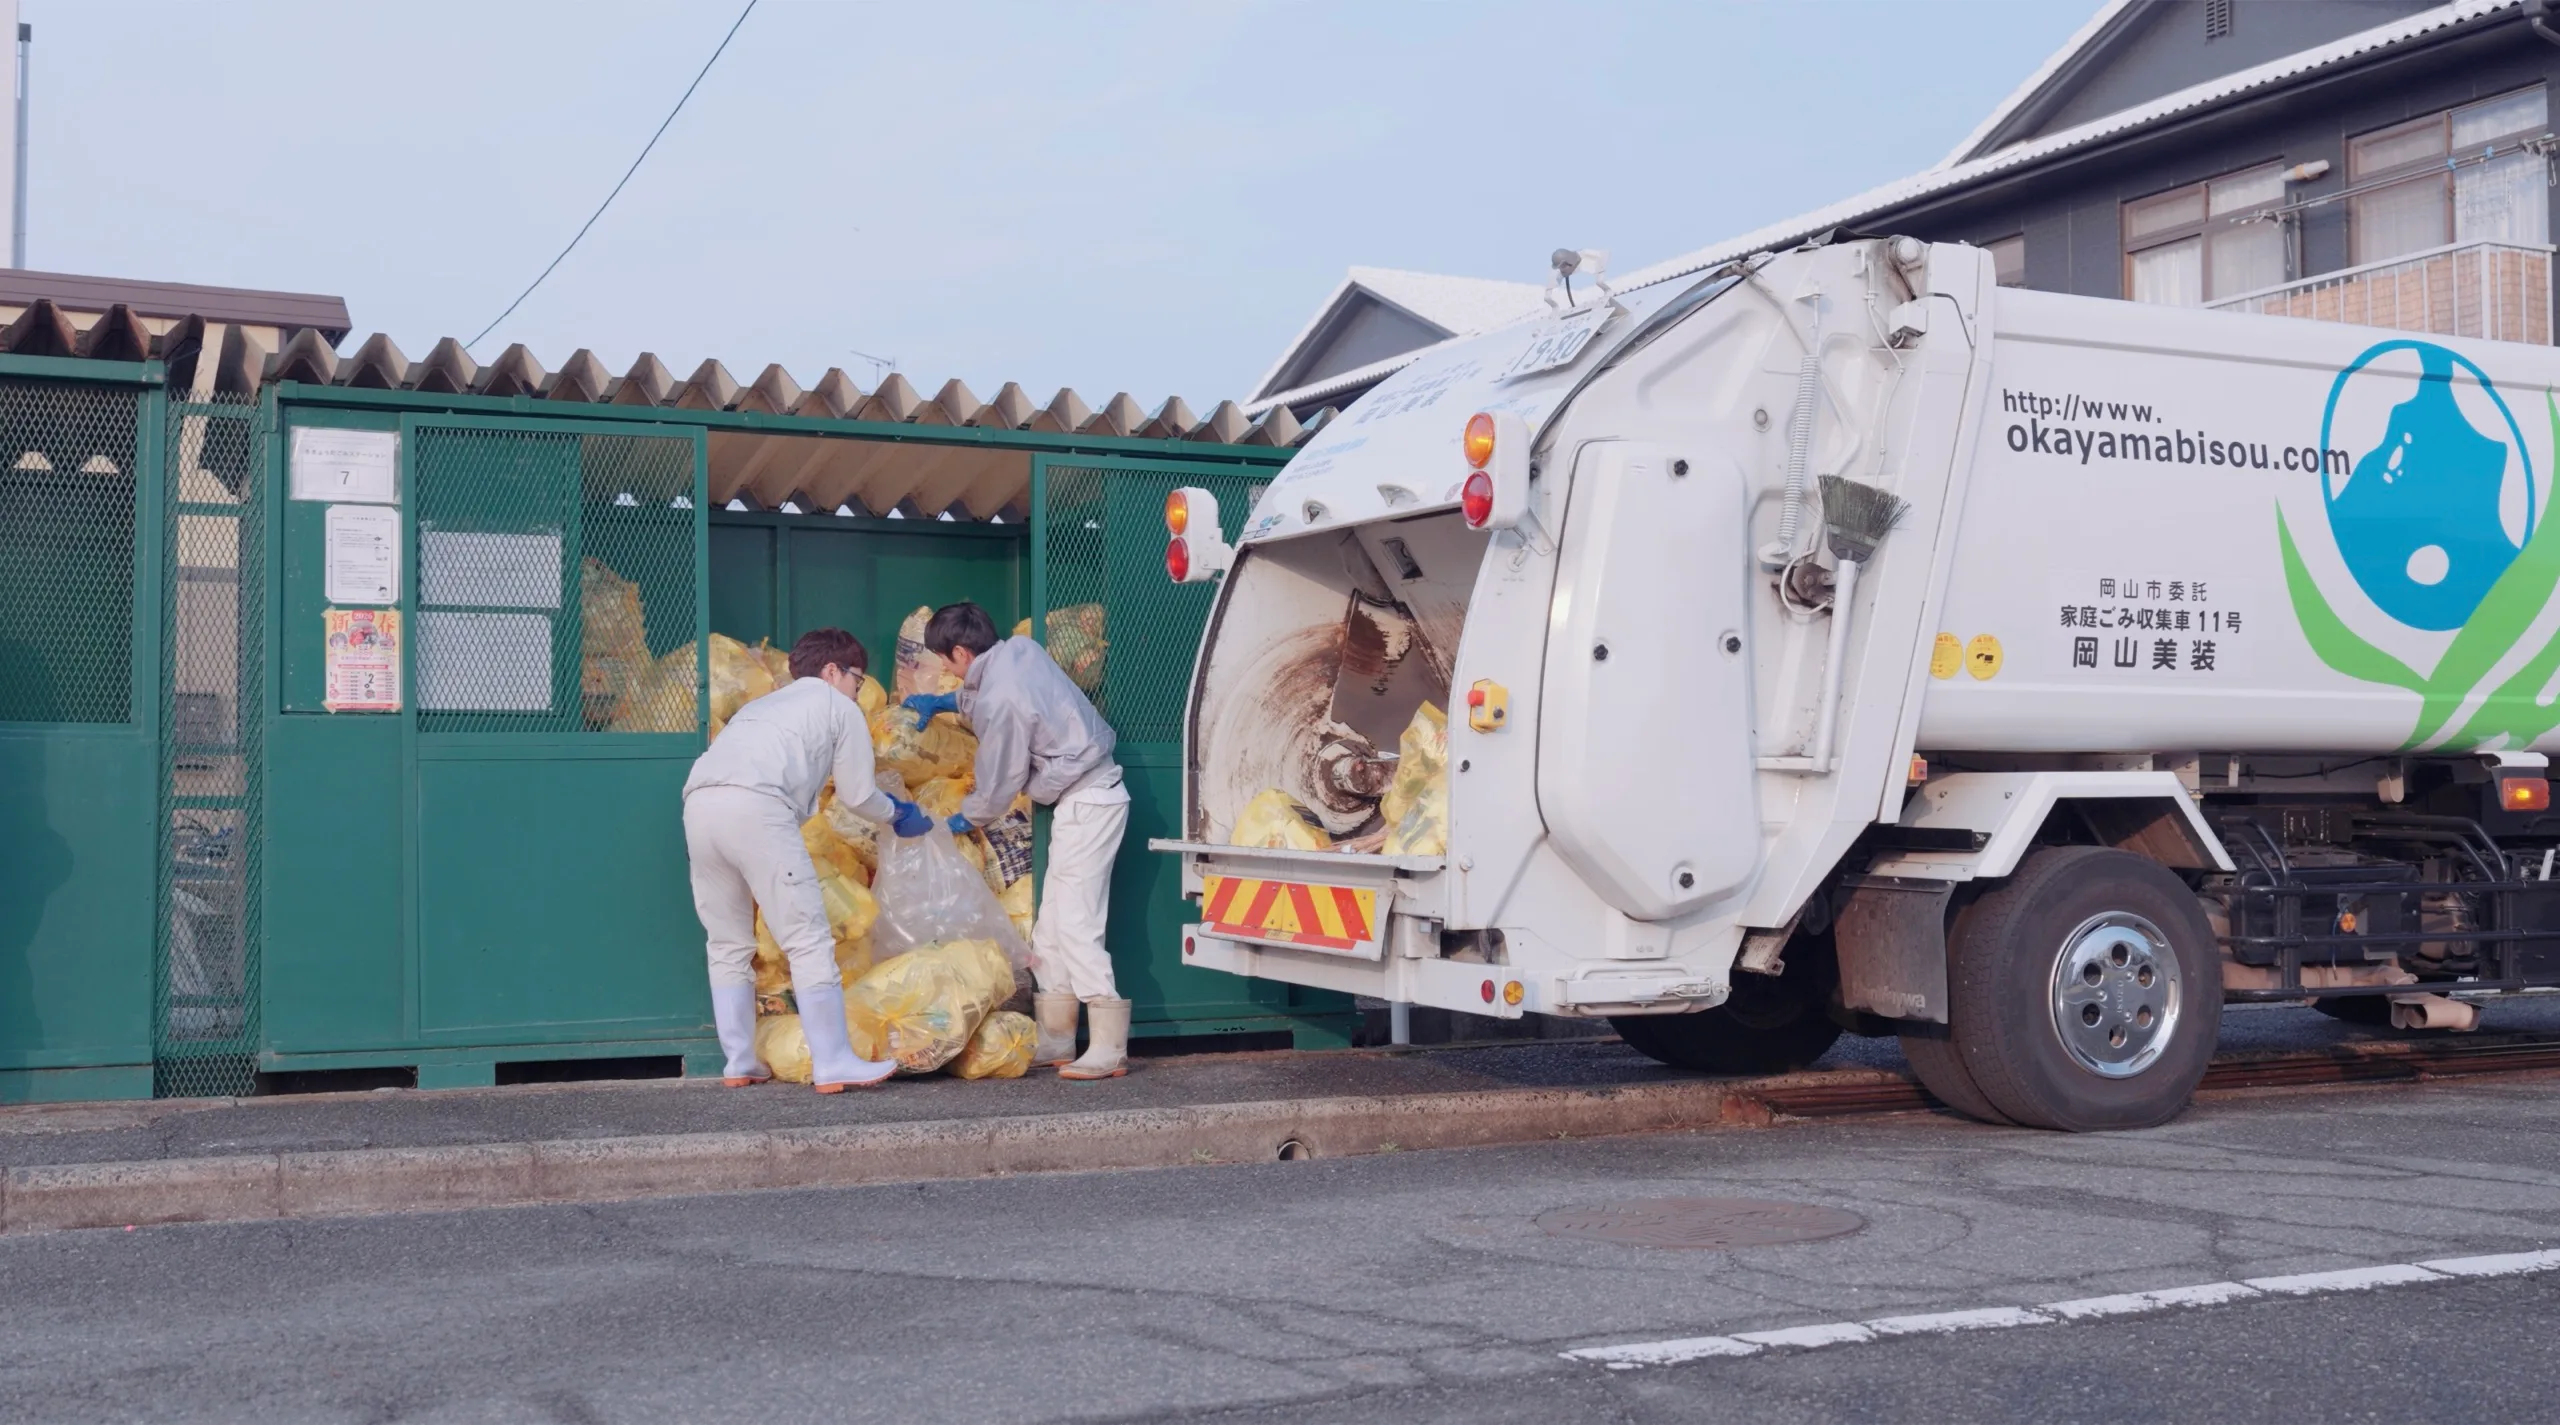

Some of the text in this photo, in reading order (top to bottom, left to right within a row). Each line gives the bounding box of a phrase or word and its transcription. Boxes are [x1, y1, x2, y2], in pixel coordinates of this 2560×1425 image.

[2003, 388, 2162, 424] http://www.
[2006, 418, 2351, 475] okayamabisou.com
[340, 470, 350, 486] 7
[2100, 578, 2206, 601] 岡山市委託
[2073, 636, 2216, 671] 岡山美装
